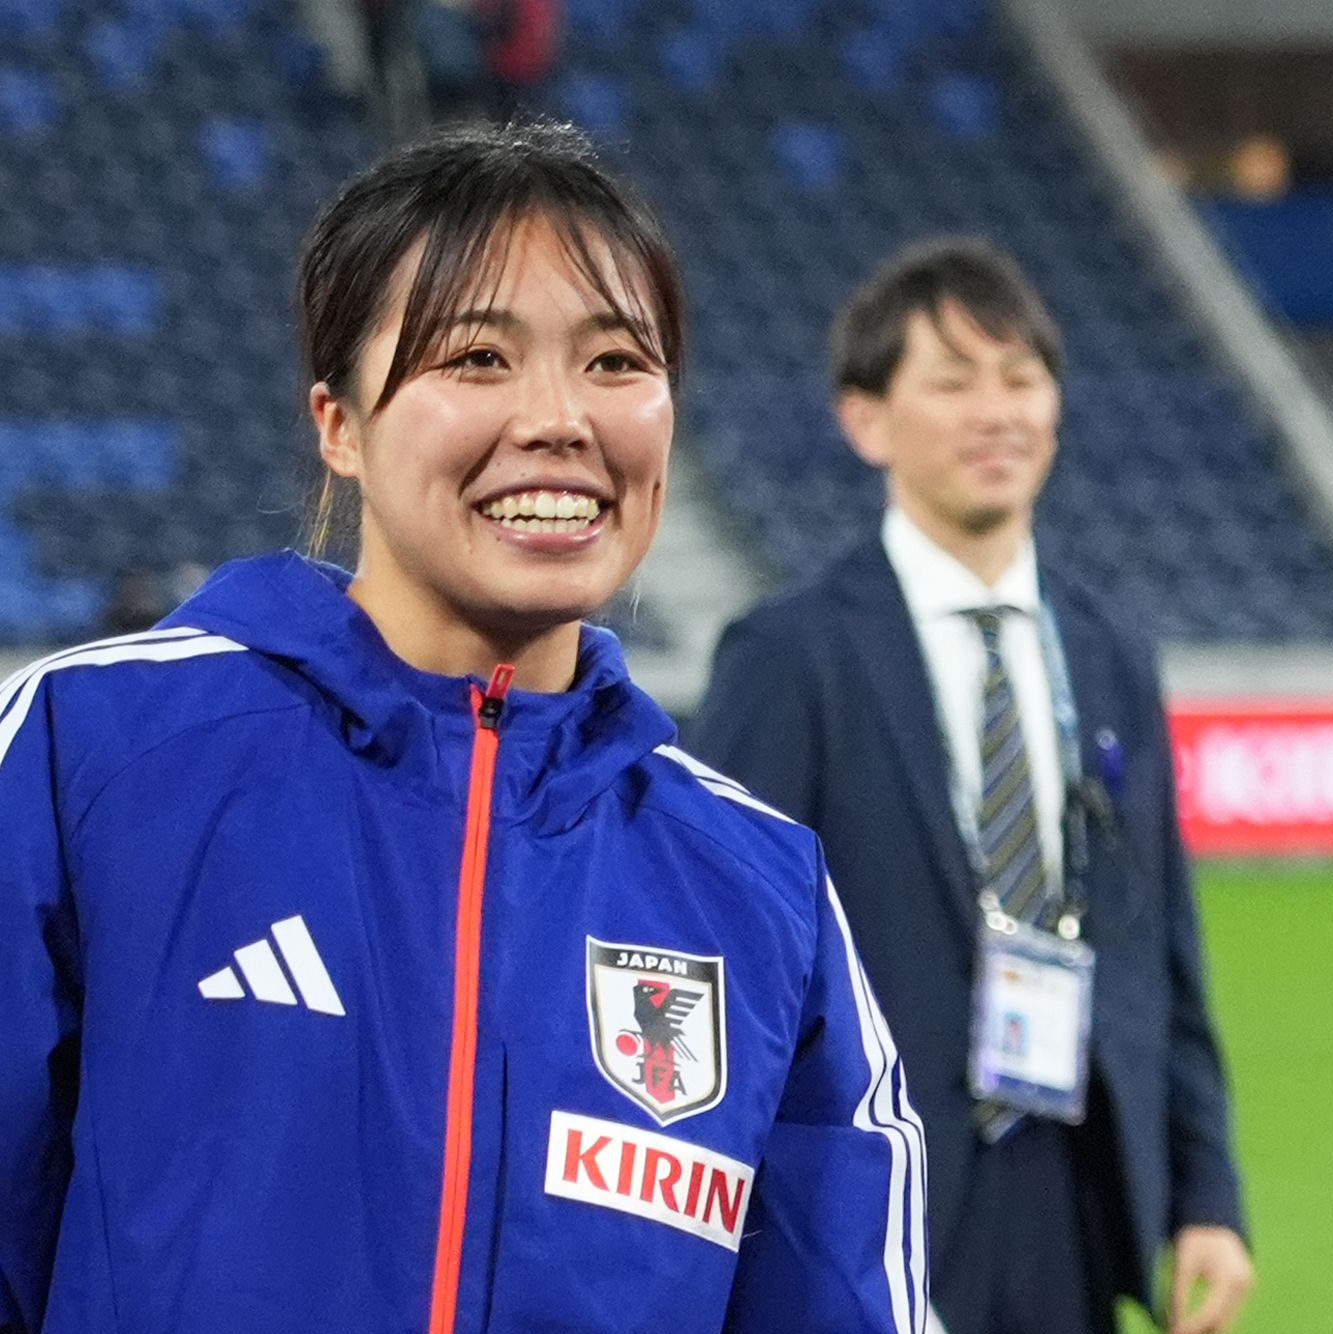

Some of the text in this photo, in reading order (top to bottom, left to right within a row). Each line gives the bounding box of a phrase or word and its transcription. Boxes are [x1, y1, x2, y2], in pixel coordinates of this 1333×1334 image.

[616, 952, 688, 975] JAPAN
[631, 1062, 687, 1096] JFA
[562, 1128, 745, 1234] KIRIN
